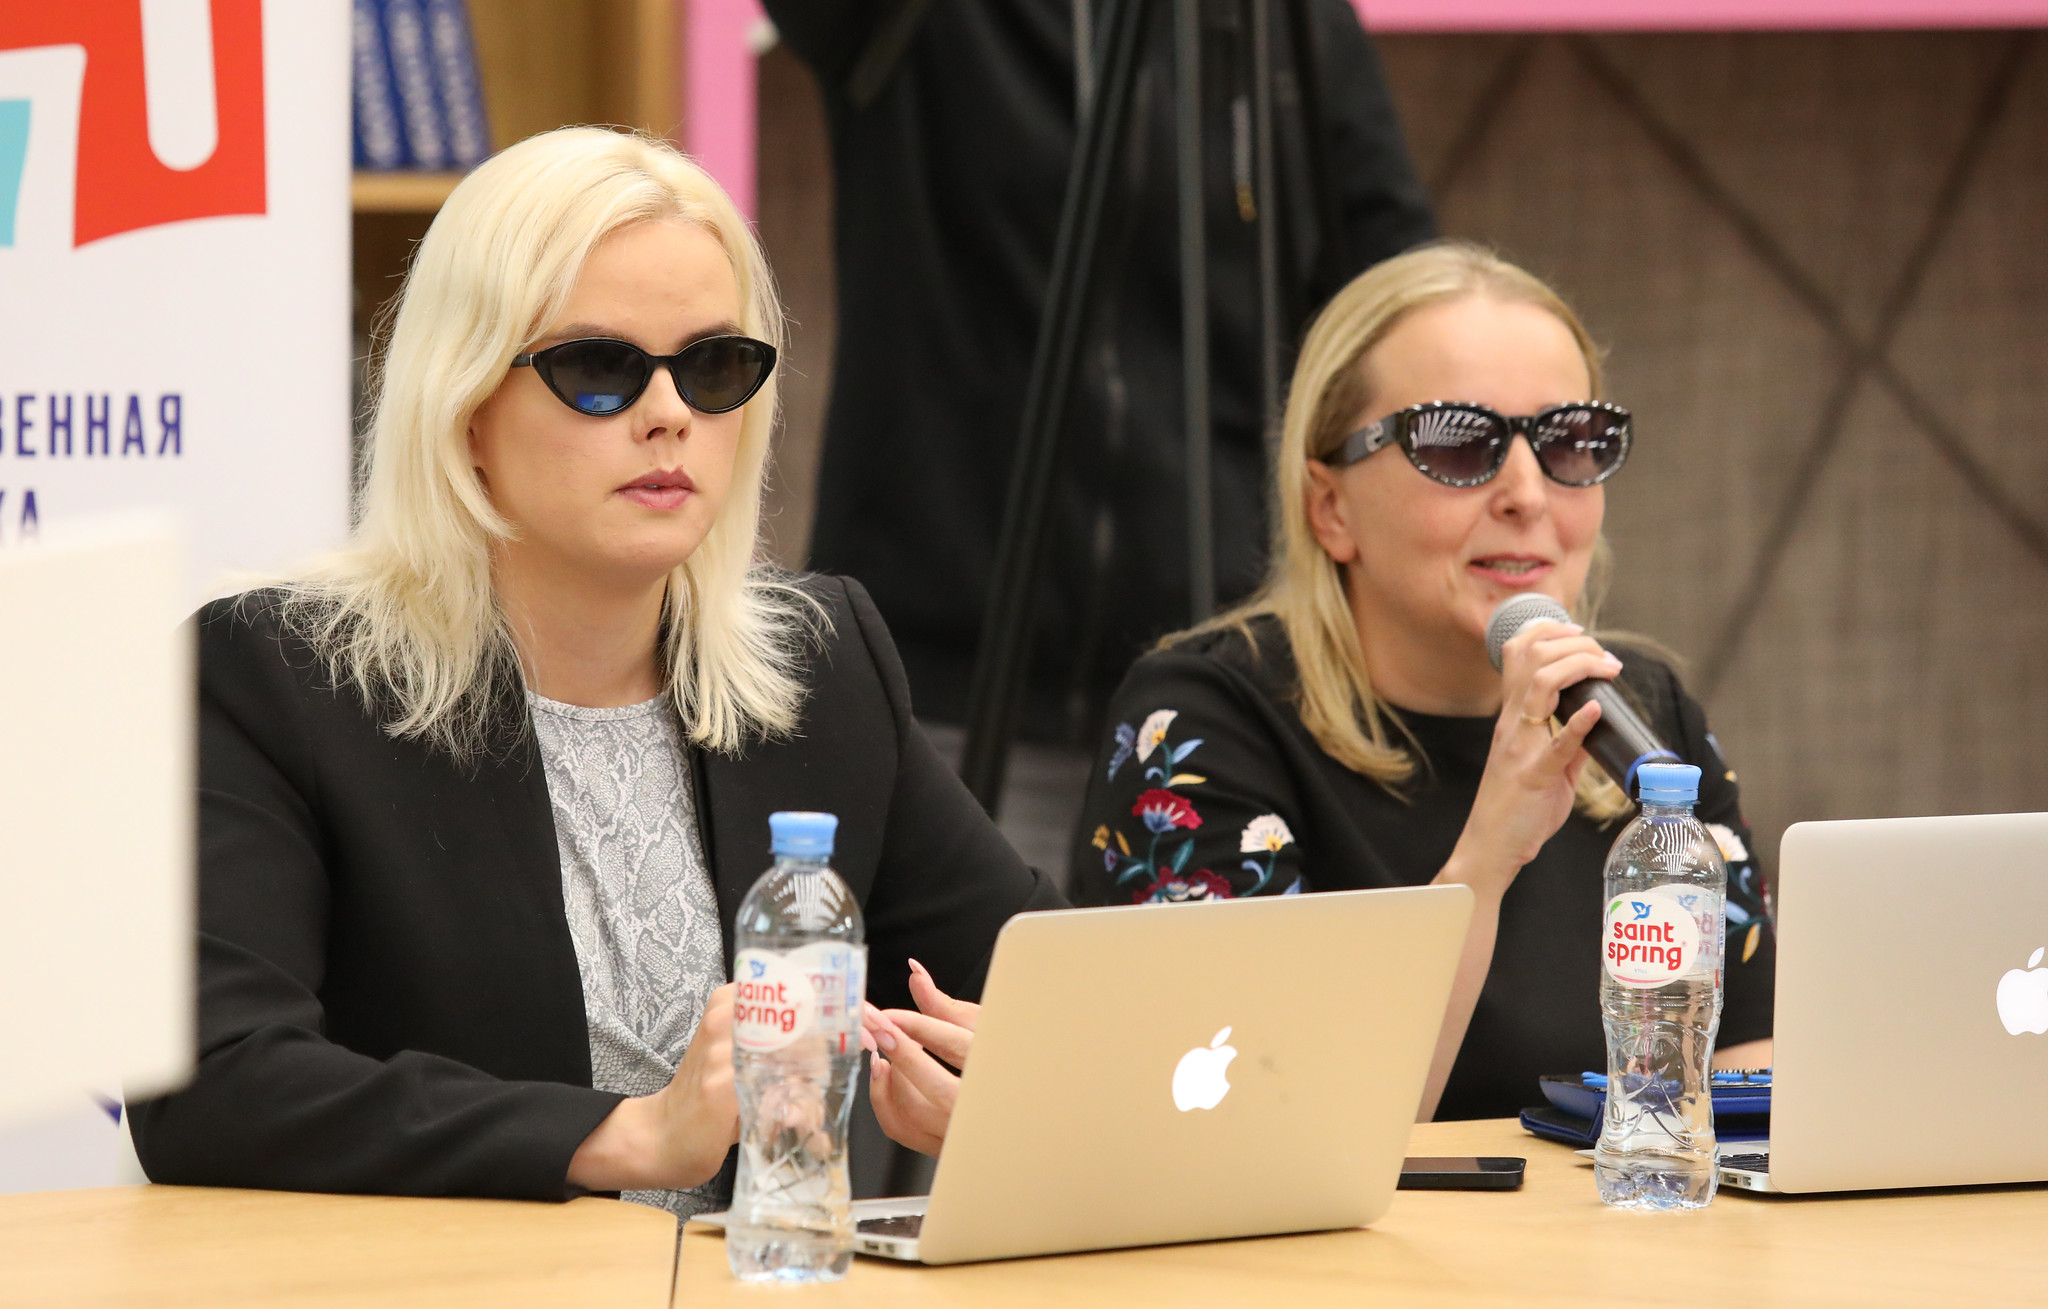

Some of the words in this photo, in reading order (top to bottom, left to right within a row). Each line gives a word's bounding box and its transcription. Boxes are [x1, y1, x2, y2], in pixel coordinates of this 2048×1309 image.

[0, 394, 182, 456] ЕННАЯ
[1613, 921, 1675, 943] saint
[1607, 941, 1682, 971] spring
